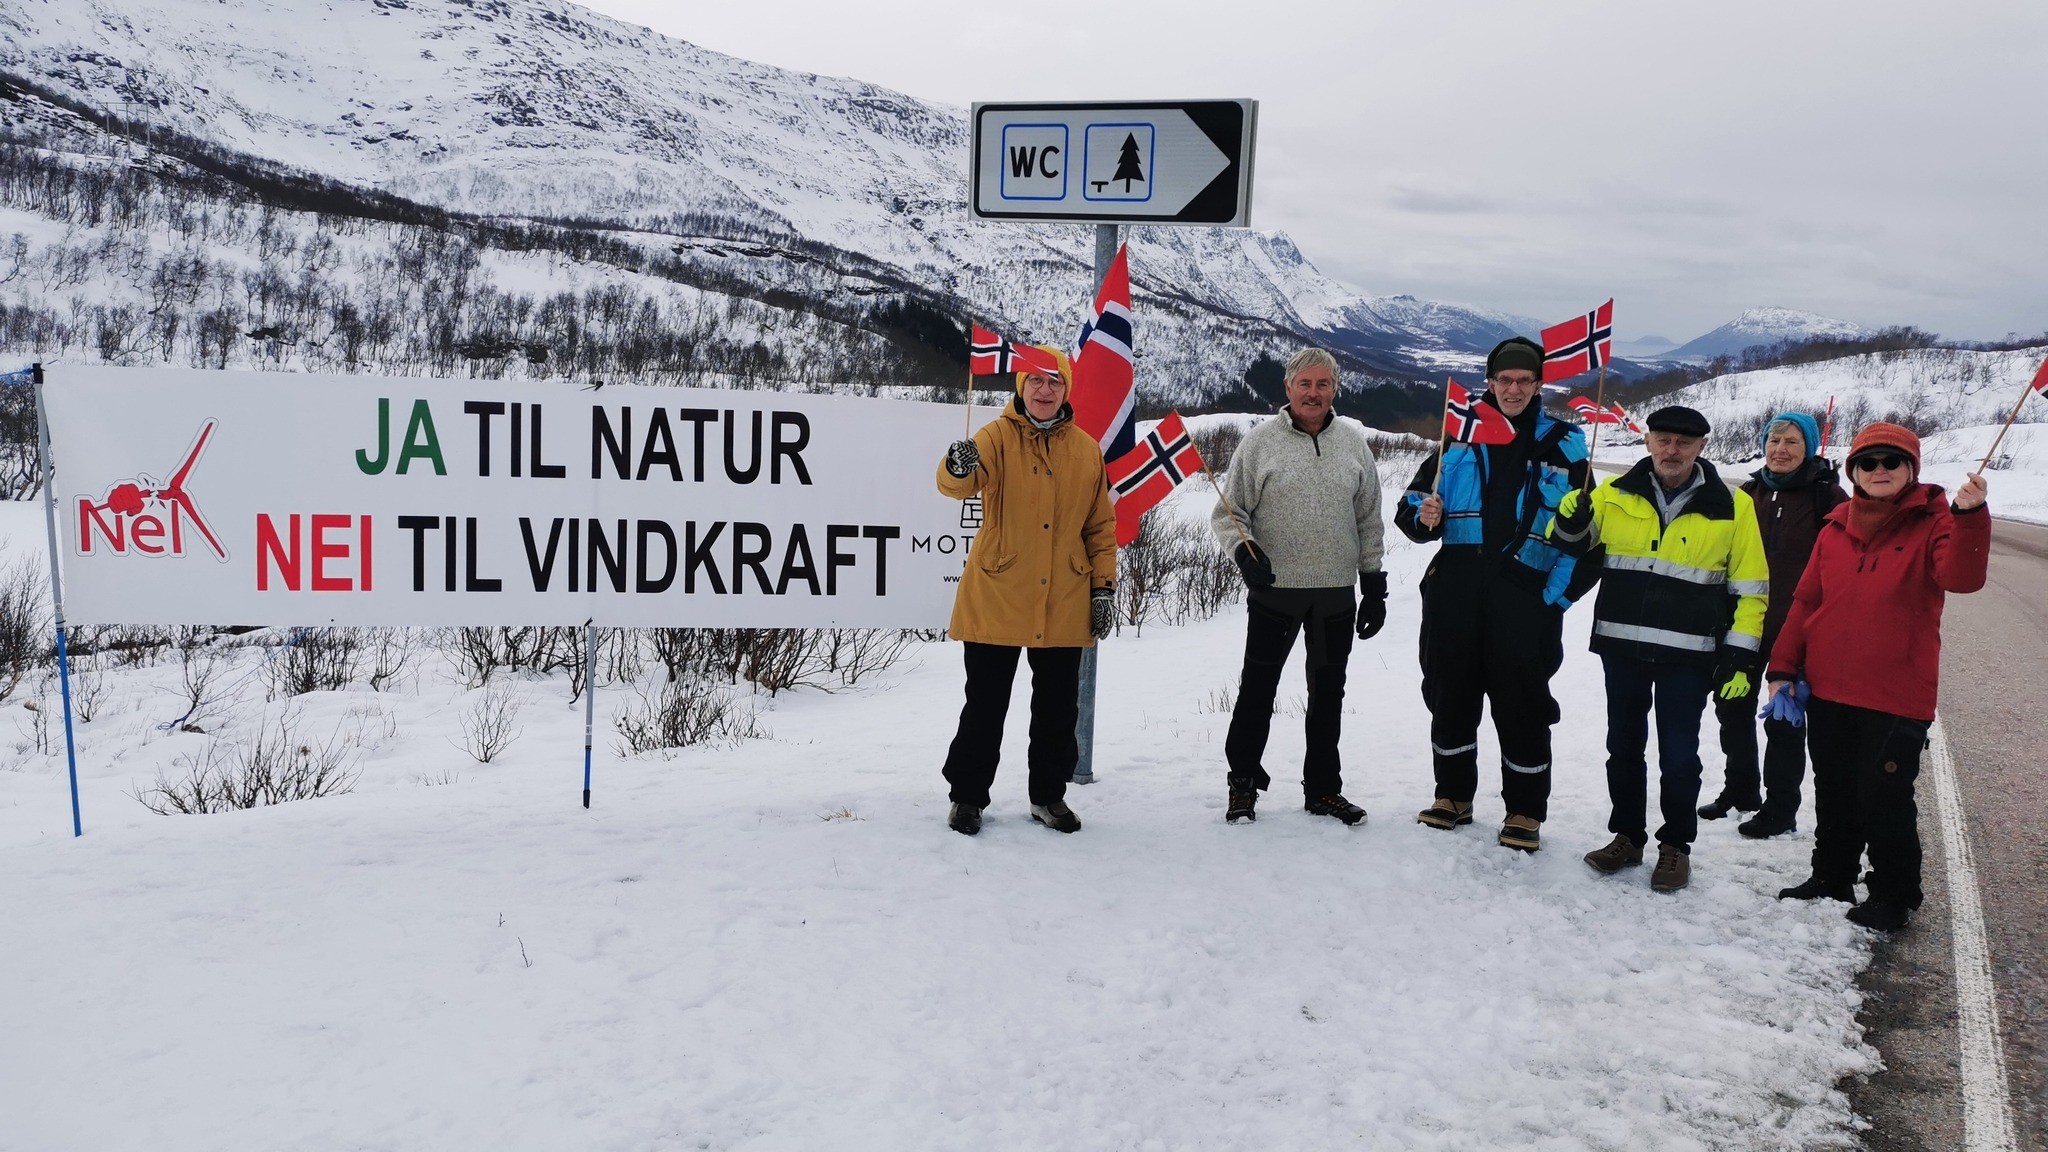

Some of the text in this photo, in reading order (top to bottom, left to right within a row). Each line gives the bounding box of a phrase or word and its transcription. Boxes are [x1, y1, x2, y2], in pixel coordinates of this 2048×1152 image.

[1009, 145, 1061, 179] WC
[355, 398, 813, 485] JA TIL NATUR
[257, 513, 900, 596] NEI TIL VINDKRAFT
[912, 535, 975, 555] MOT
